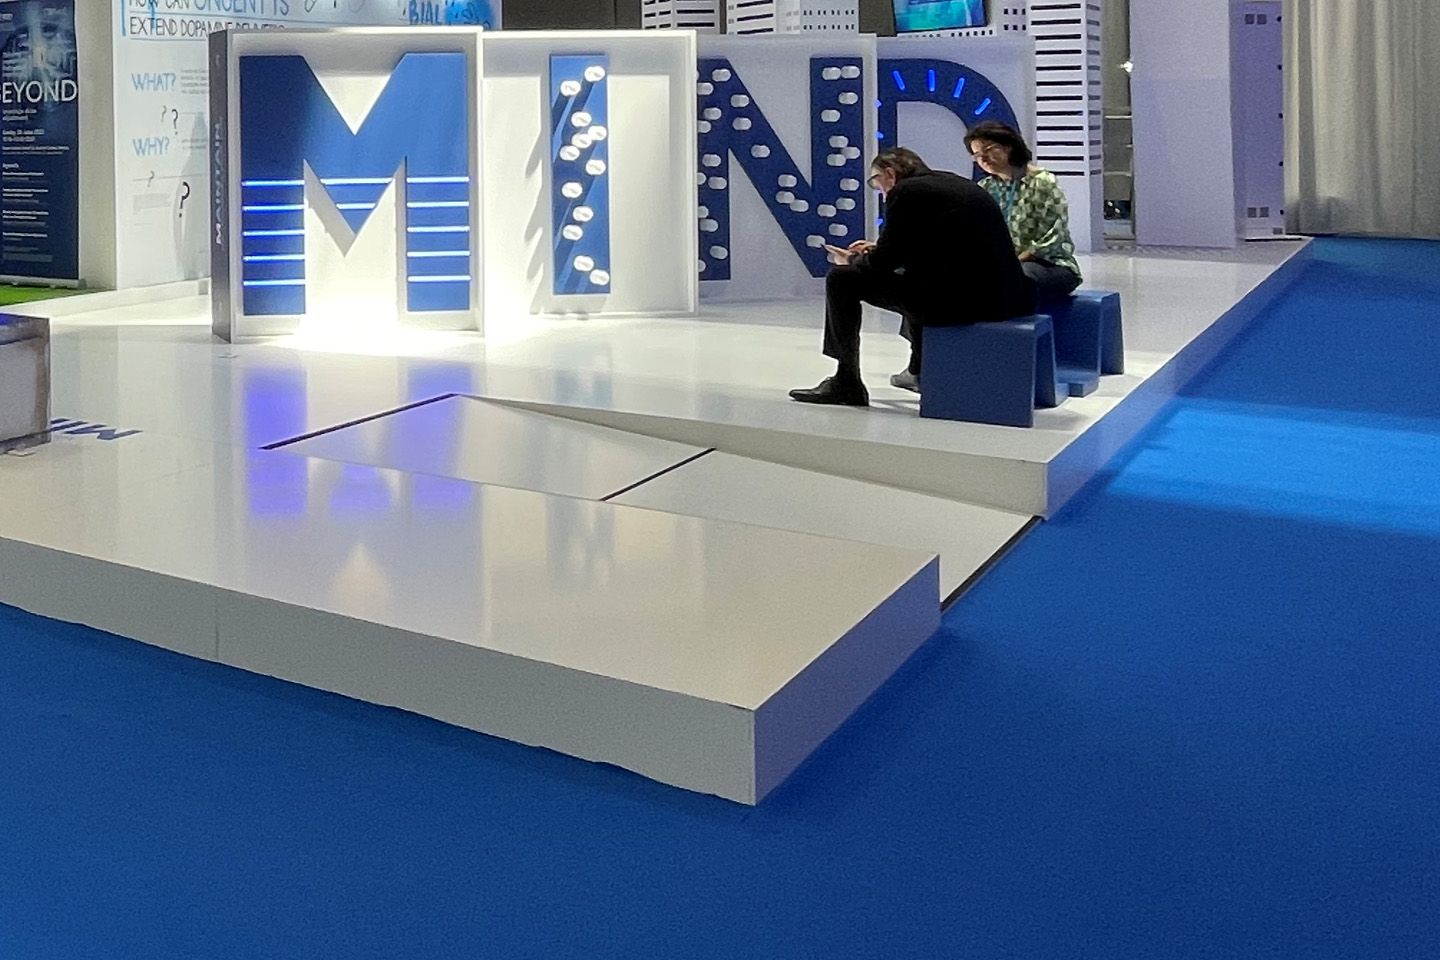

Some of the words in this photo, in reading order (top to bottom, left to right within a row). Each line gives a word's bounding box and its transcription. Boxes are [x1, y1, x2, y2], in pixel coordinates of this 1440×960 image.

[129, 17, 178, 36] EXTEND
[131, 72, 177, 91] WHAT?
[132, 136, 171, 156] WHY?
